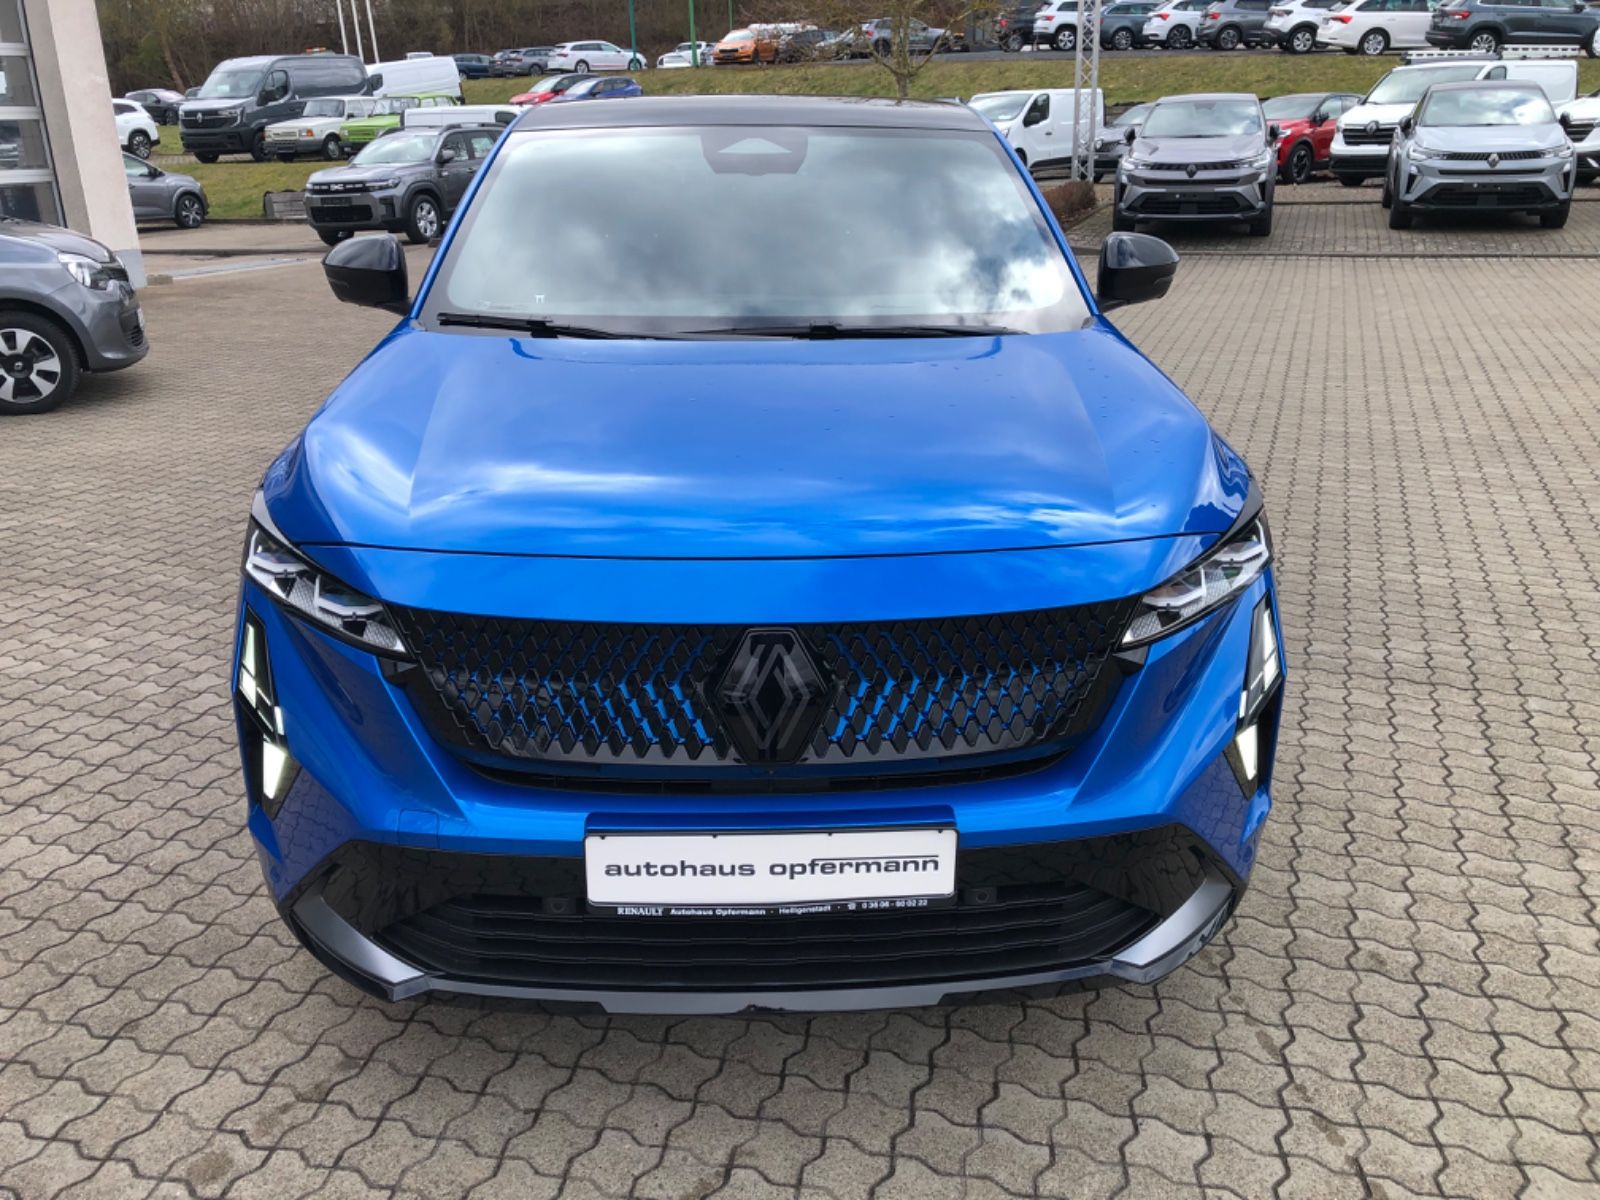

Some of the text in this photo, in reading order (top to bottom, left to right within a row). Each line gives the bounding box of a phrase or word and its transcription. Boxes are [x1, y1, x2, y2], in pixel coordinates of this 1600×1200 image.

[605, 855, 939, 880] autohaus opfermann
[617, 906, 664, 916] RENAULT
[670, 908, 713, 916] Autohaus
[715, 908, 766, 917] Opfermann
[778, 904, 831, 916] Heiligenstadt
